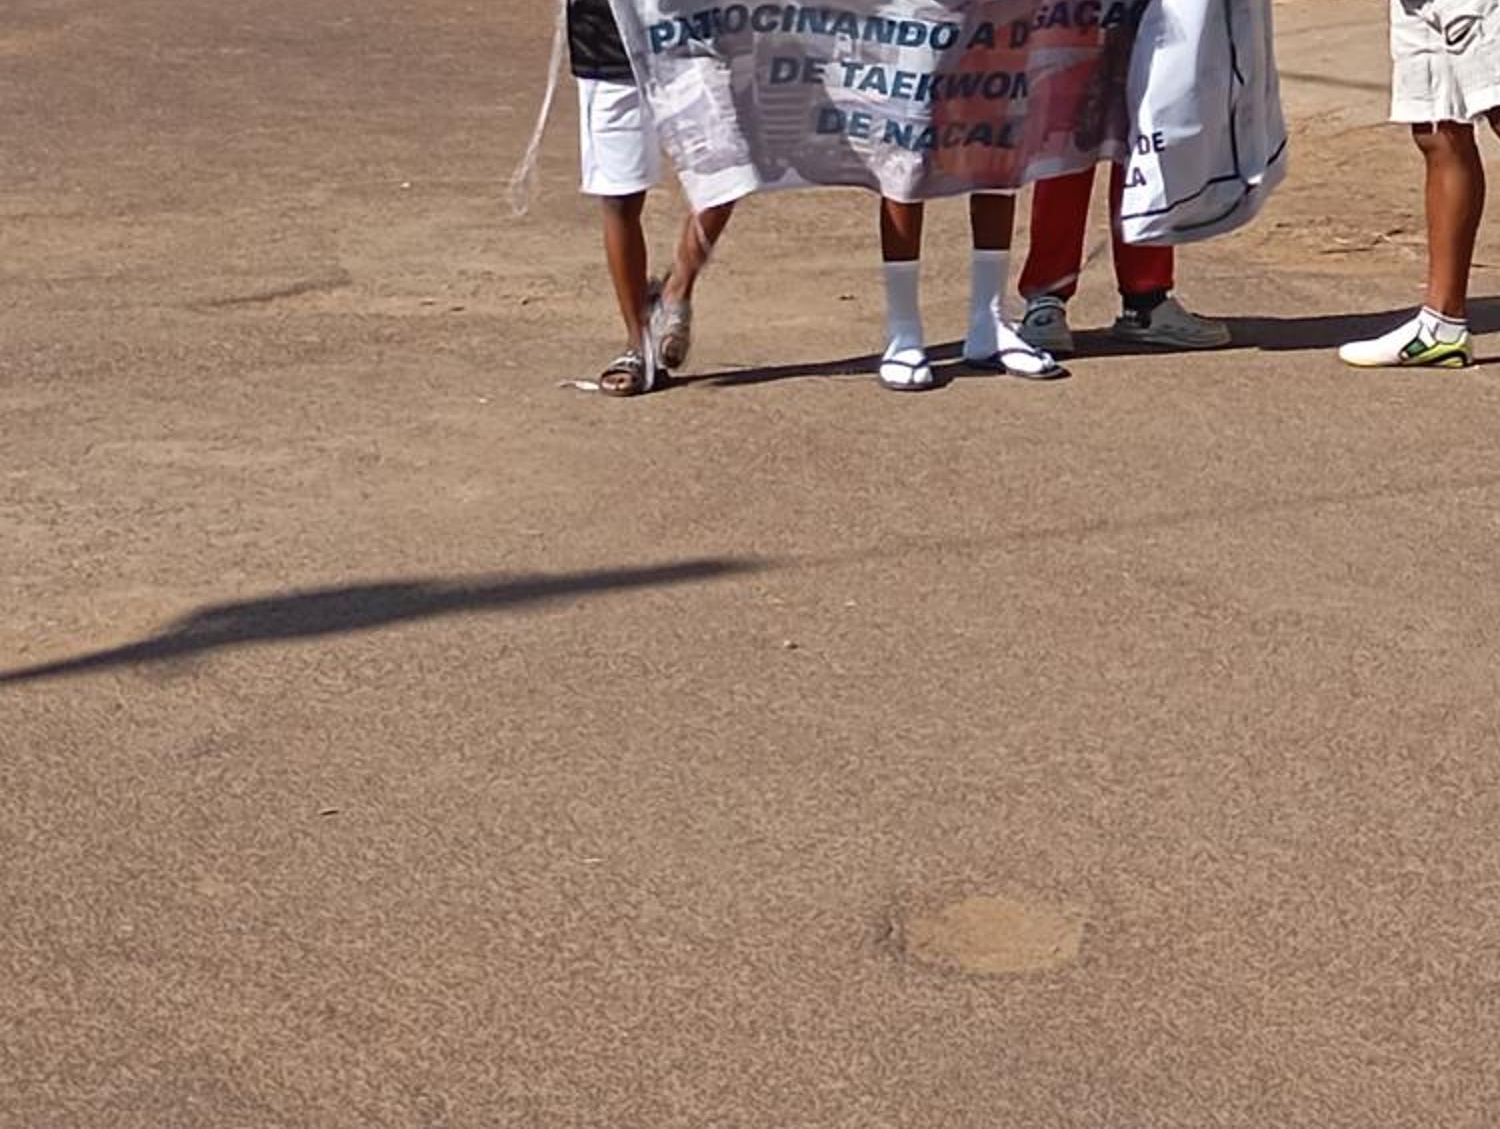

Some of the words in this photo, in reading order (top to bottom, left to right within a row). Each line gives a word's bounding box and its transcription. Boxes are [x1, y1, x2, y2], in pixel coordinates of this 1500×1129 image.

[966, 21, 995, 50] A
[768, 56, 828, 86] DE
[815, 107, 873, 140] DE
[1137, 131, 1166, 156] DE
